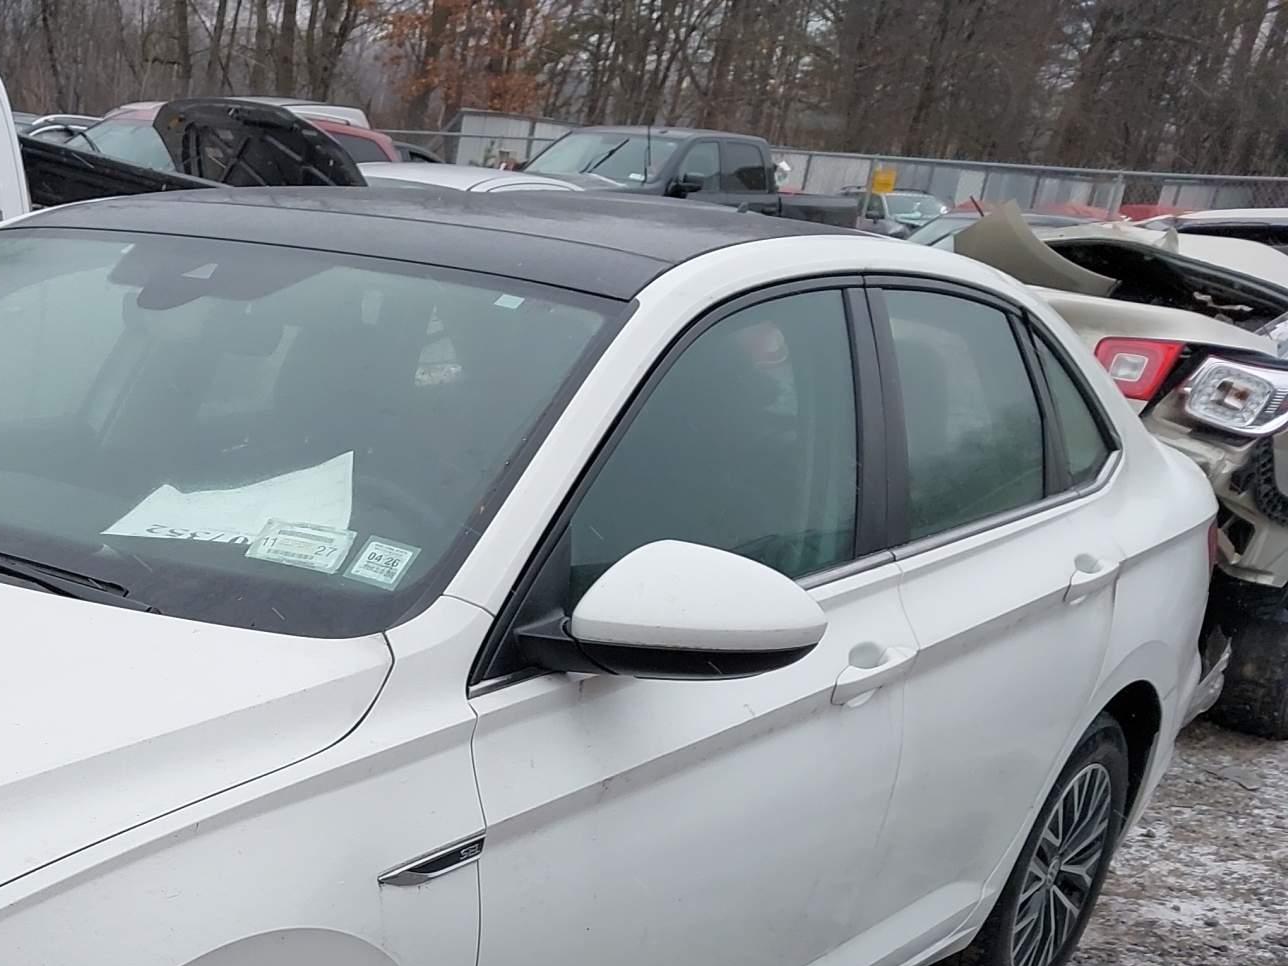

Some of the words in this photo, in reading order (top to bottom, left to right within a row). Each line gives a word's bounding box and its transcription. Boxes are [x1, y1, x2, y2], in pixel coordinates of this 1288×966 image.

[314, 545, 338, 558] 27
[367, 551, 384, 563] 04
[383, 556, 401, 568] 26
